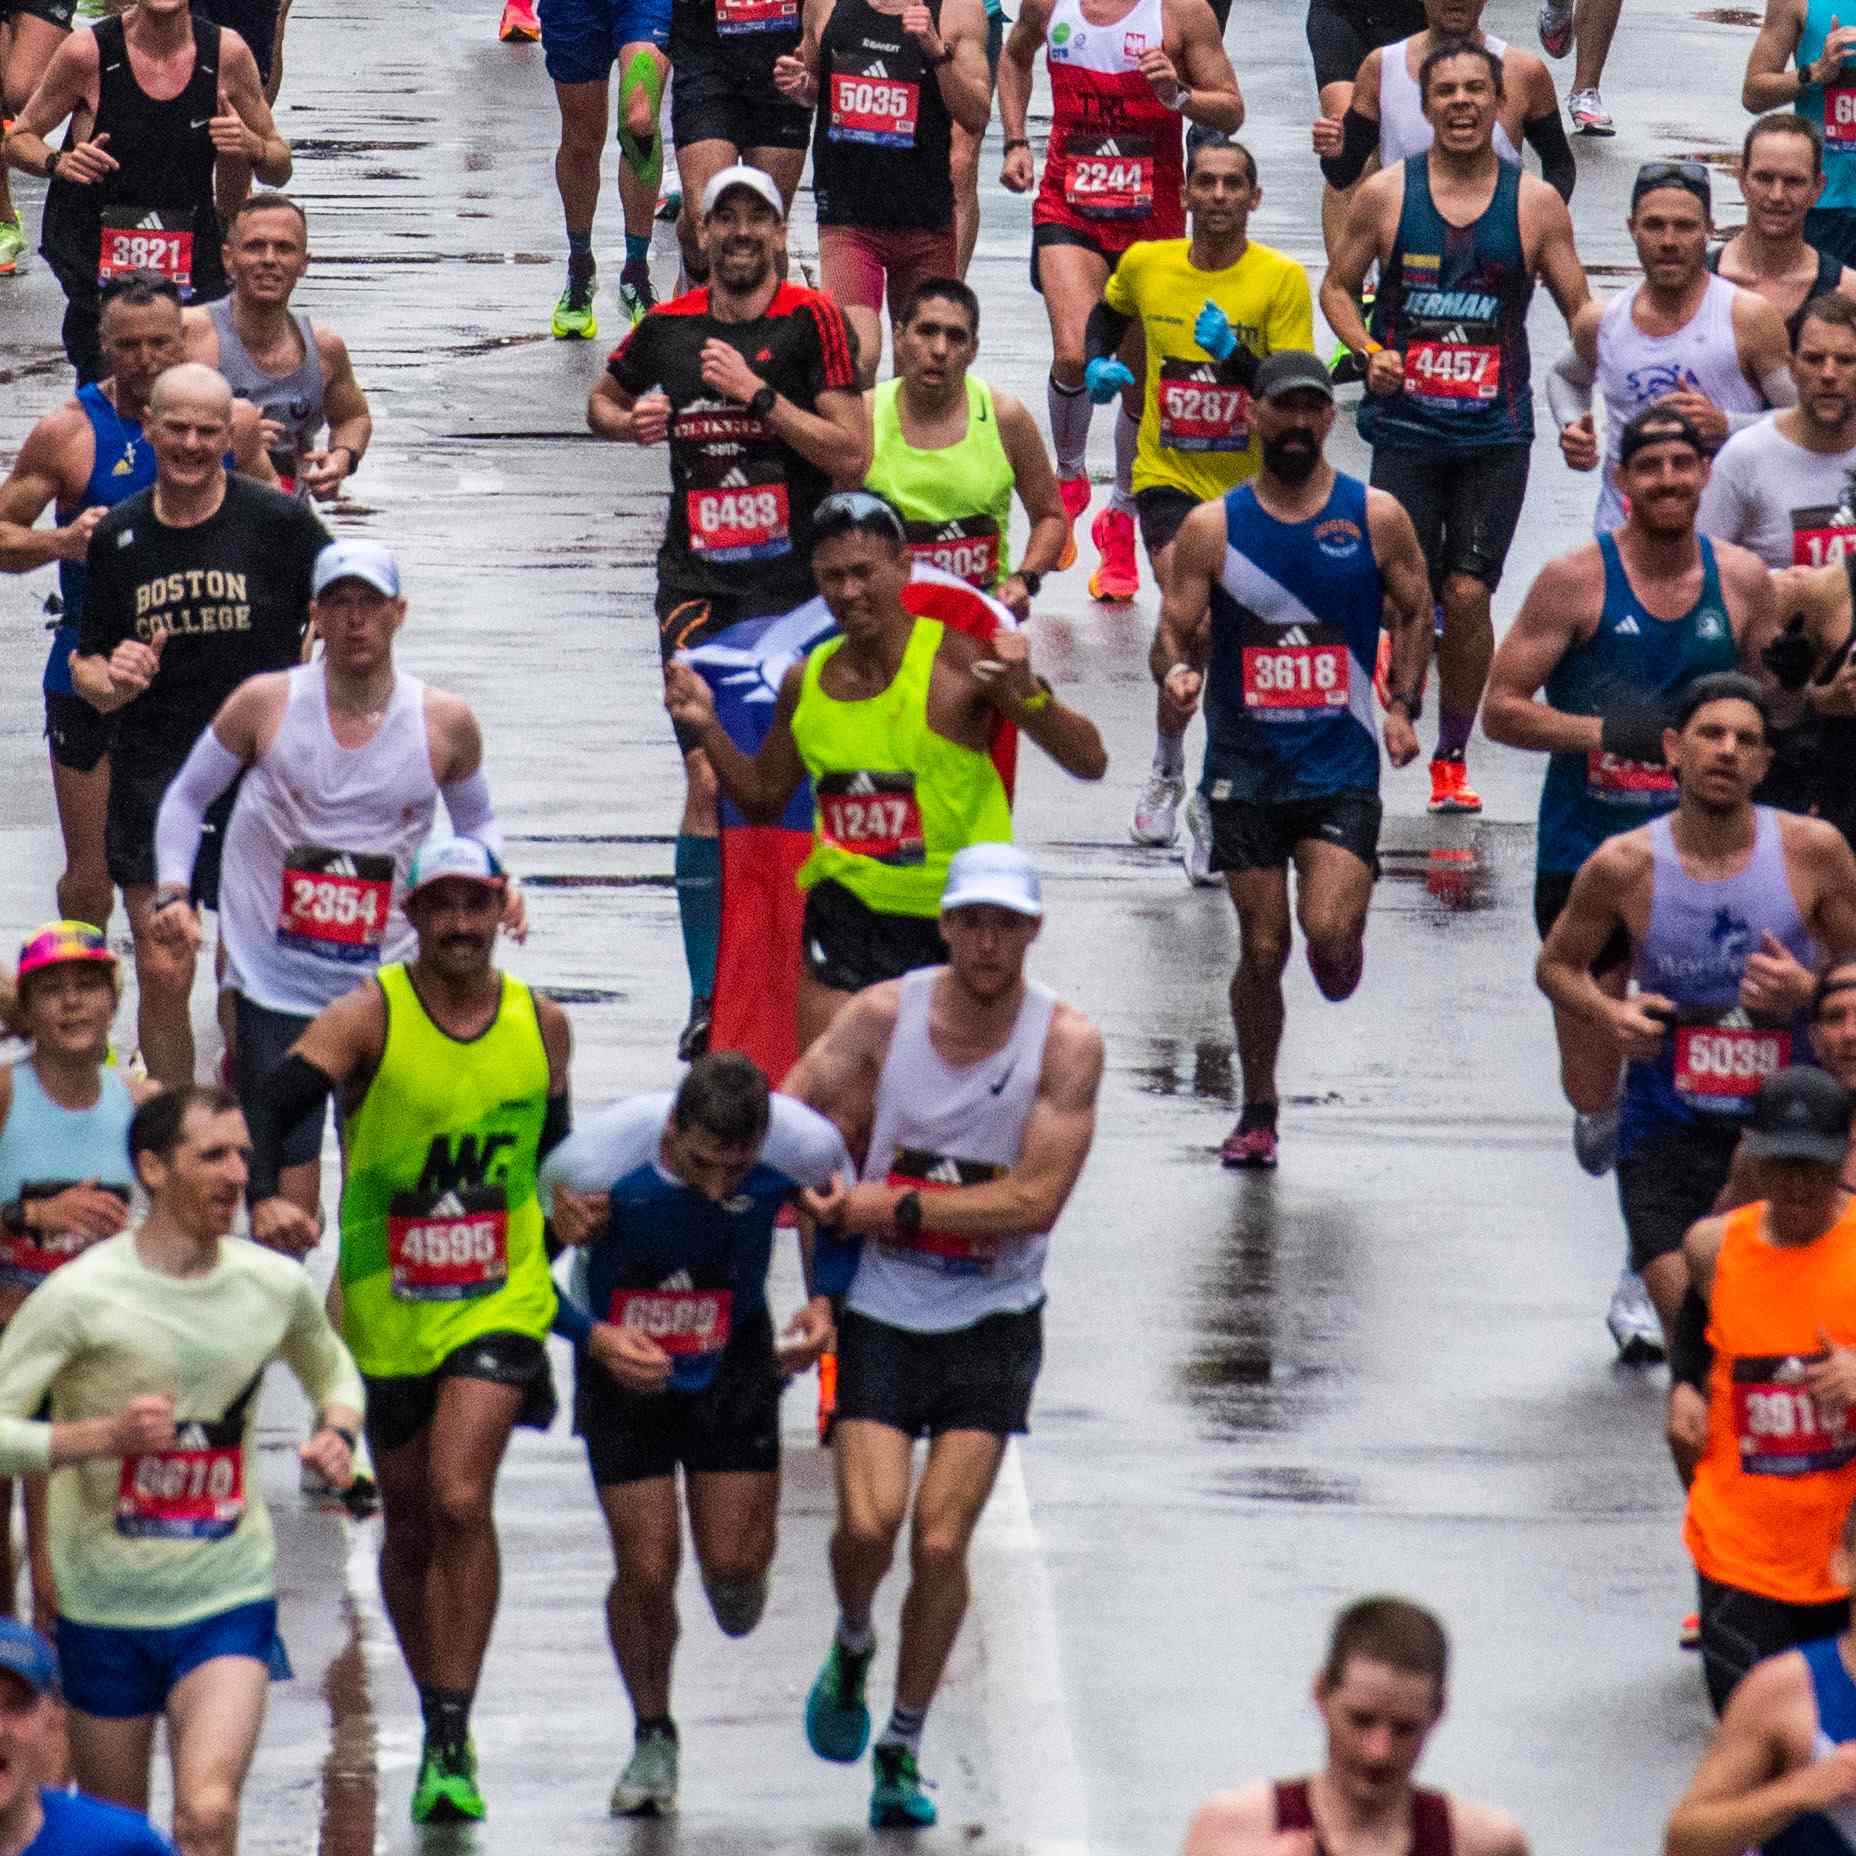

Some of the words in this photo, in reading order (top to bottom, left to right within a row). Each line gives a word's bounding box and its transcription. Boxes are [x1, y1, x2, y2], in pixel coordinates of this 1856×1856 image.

[839, 83, 908, 116] 5035
[1075, 165, 1140, 192] 2244
[111, 236, 180, 268] 3821
[1415, 348, 1486, 381] 4457
[1167, 387, 1238, 421] 5287
[699, 496, 778, 529] 6433
[136, 570, 247, 608] BOSTON
[136, 605, 251, 639] COLLEGE
[1255, 653, 1337, 690] 3618
[832, 801, 906, 839] 1247
[291, 883, 378, 921] 2354
